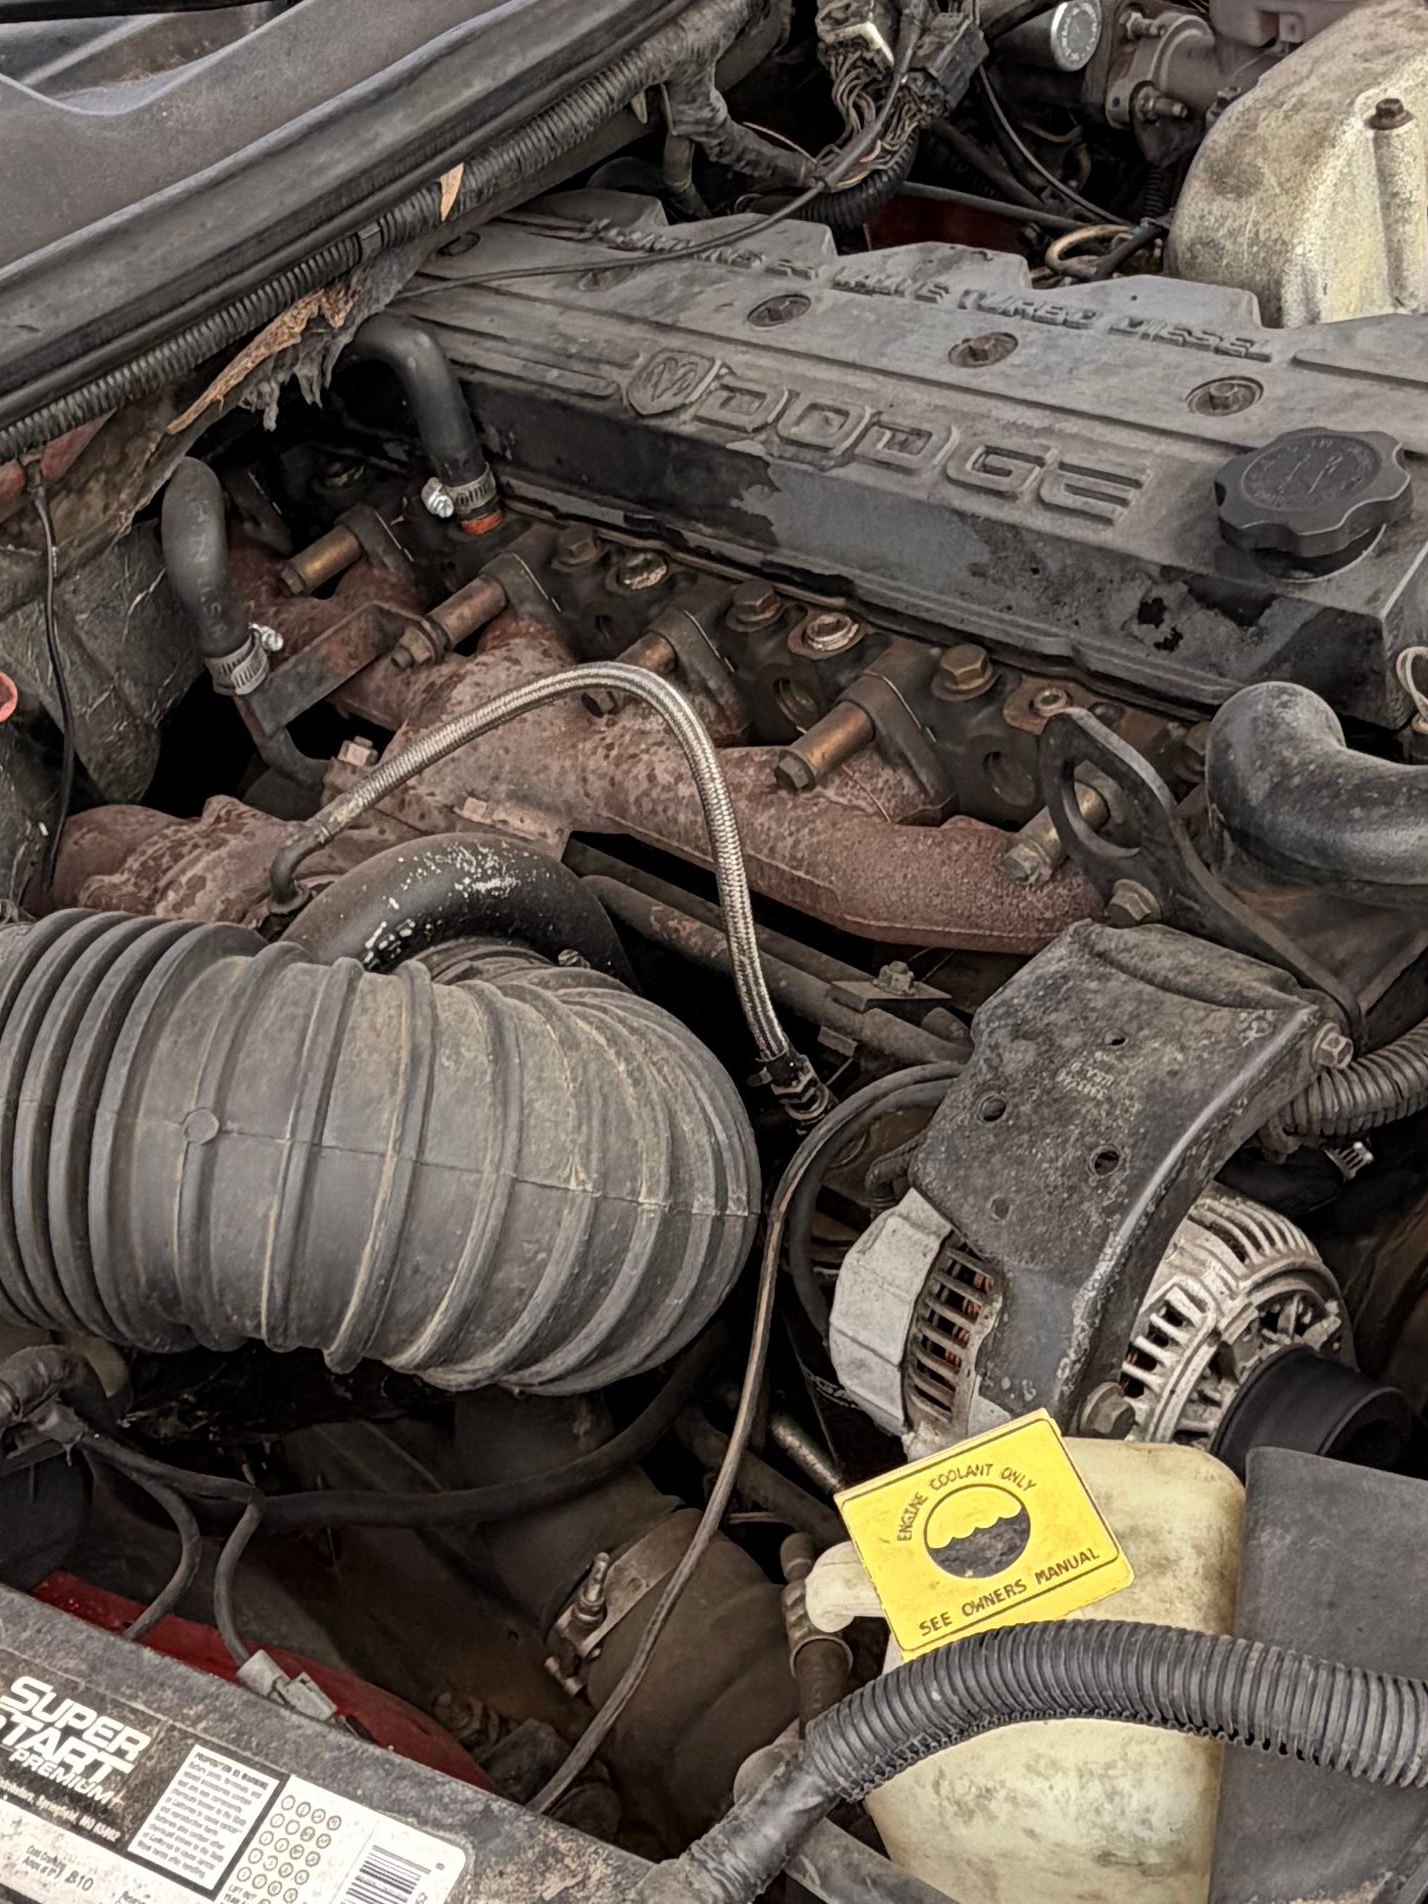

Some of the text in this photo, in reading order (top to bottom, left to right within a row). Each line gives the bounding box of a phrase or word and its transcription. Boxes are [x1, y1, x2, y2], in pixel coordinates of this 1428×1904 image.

[694, 381, 1152, 525] DODGE
[897, 1463, 1037, 1541] ENGINE COOLANT ONLY
[918, 1546, 1100, 1637] SEE OWNERS MANUAL
[9, 1745, 115, 1804] PREMIUM
